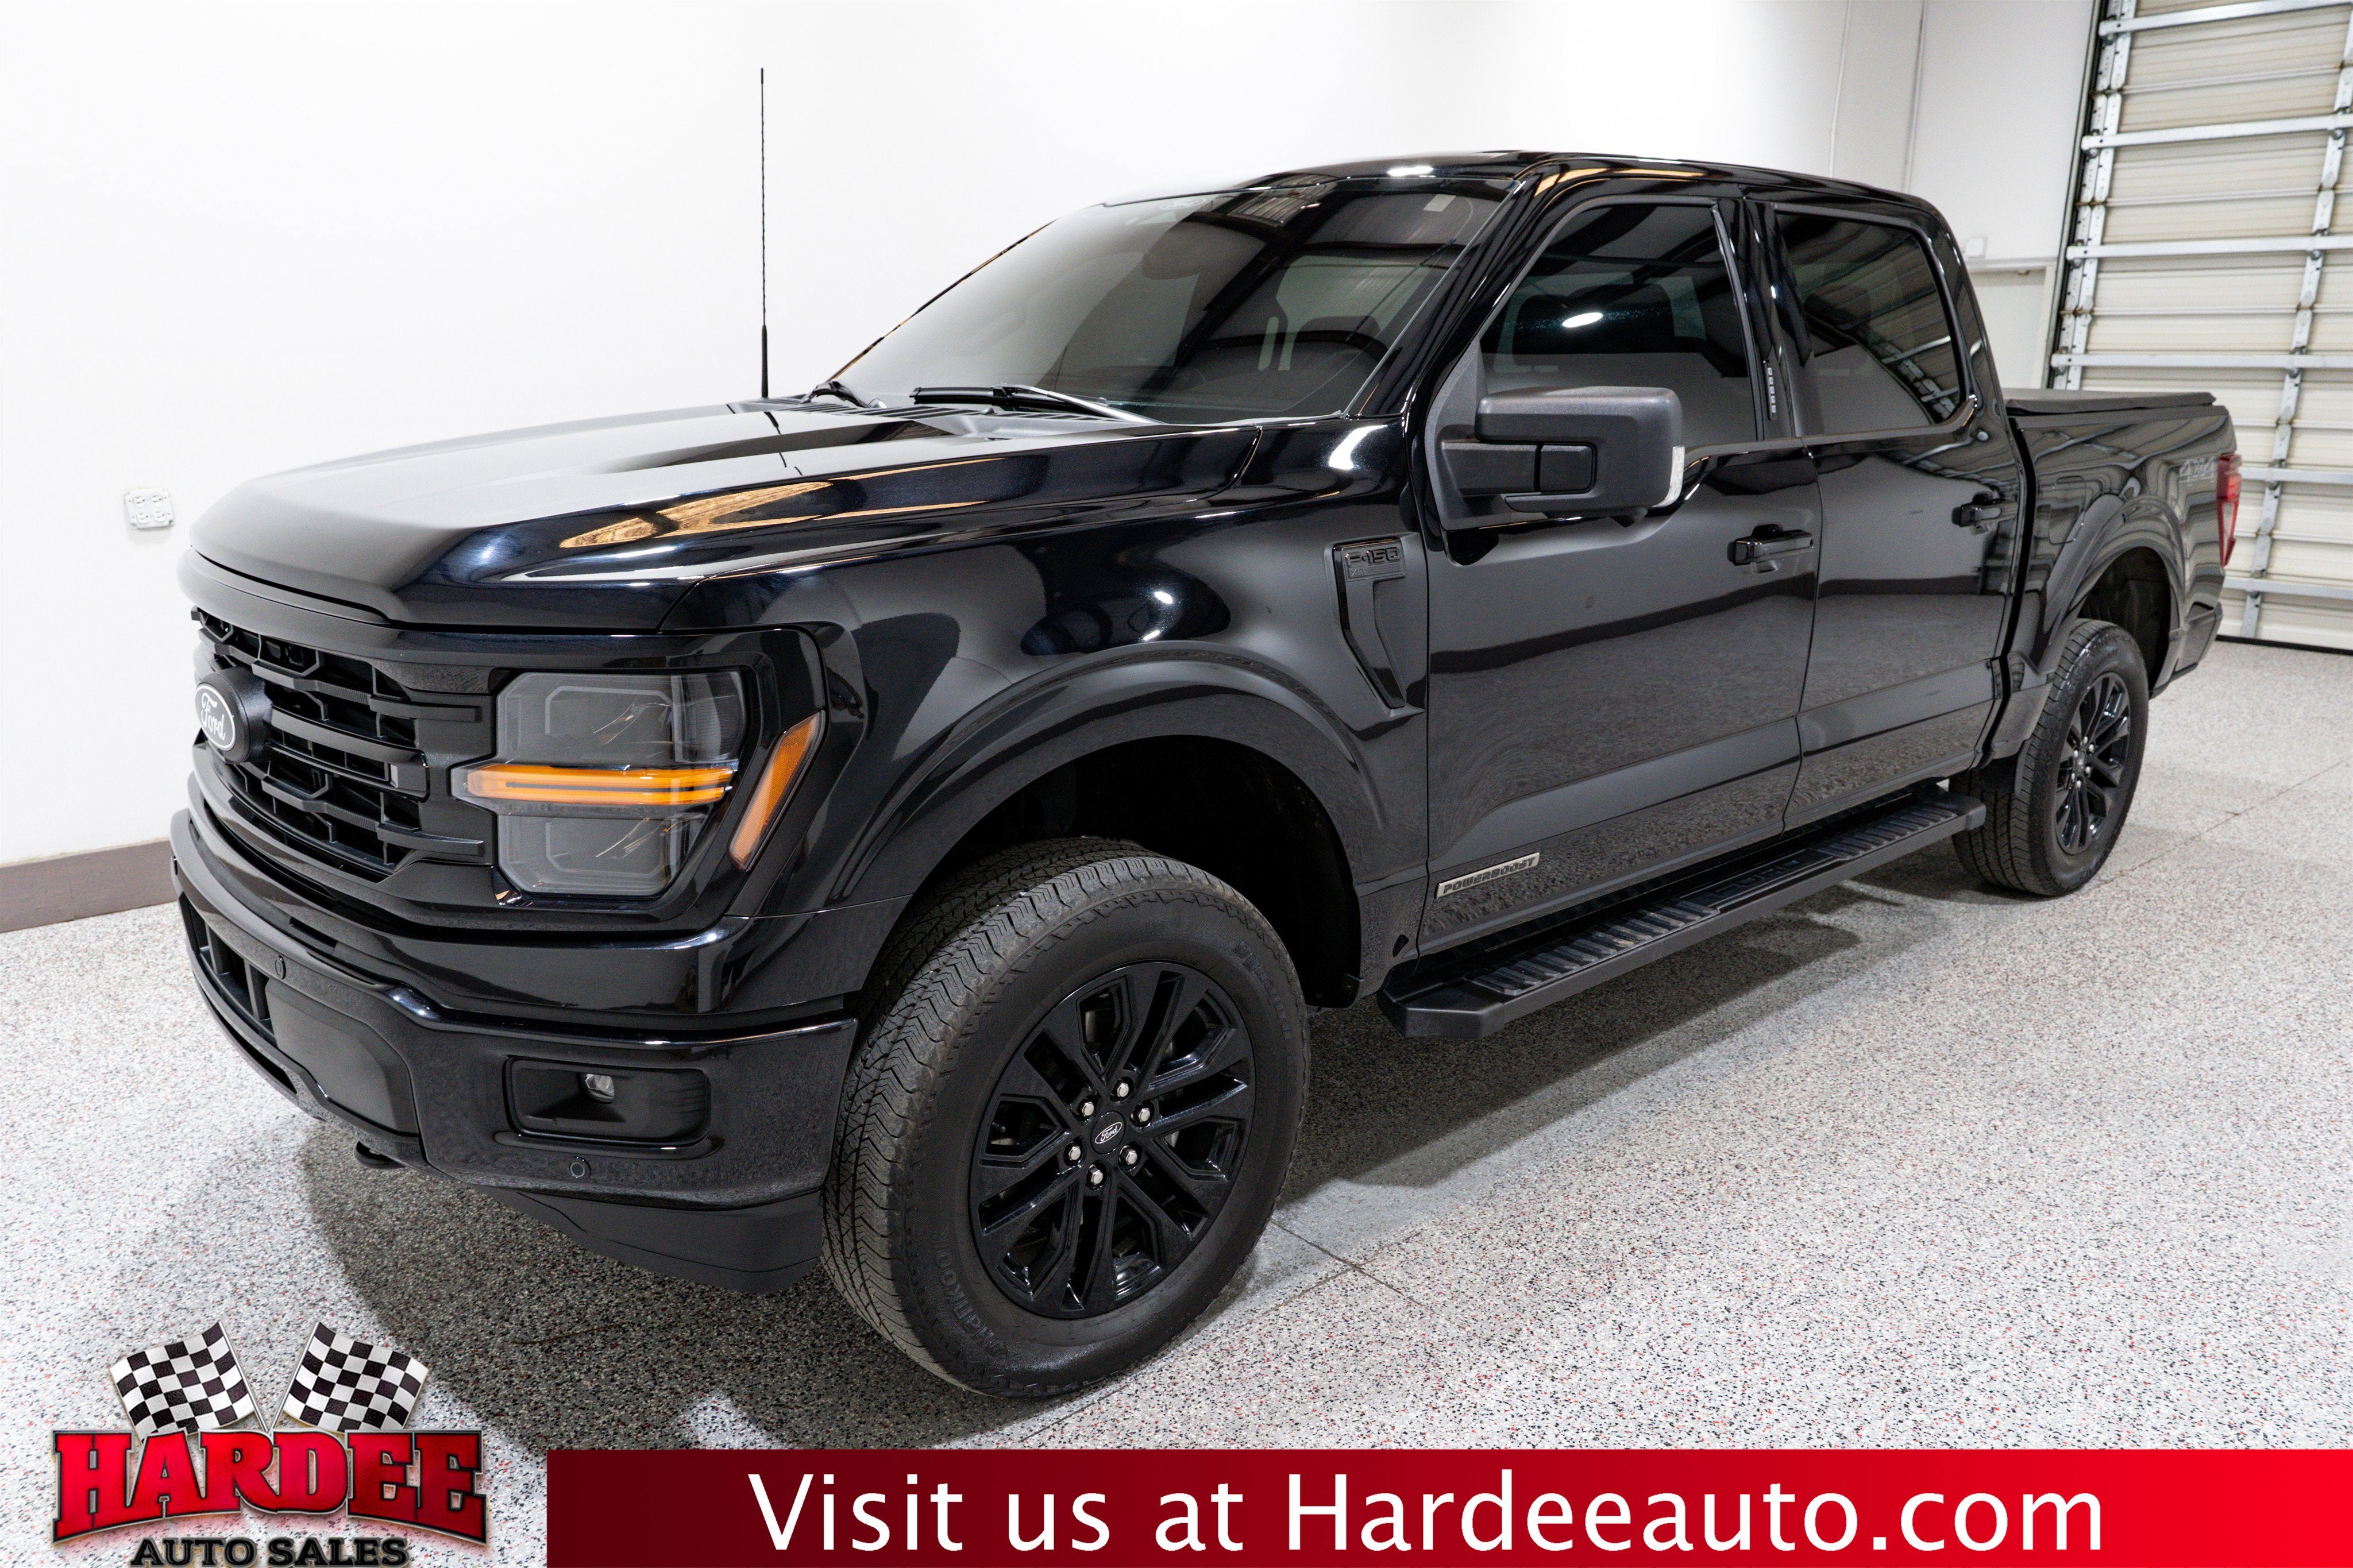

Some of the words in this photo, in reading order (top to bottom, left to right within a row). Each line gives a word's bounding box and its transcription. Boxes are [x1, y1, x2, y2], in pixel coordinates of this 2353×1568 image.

[1344, 547, 1401, 567] F-150
[200, 692, 226, 741] Ford
[1442, 856, 1536, 894] POWERBOOST
